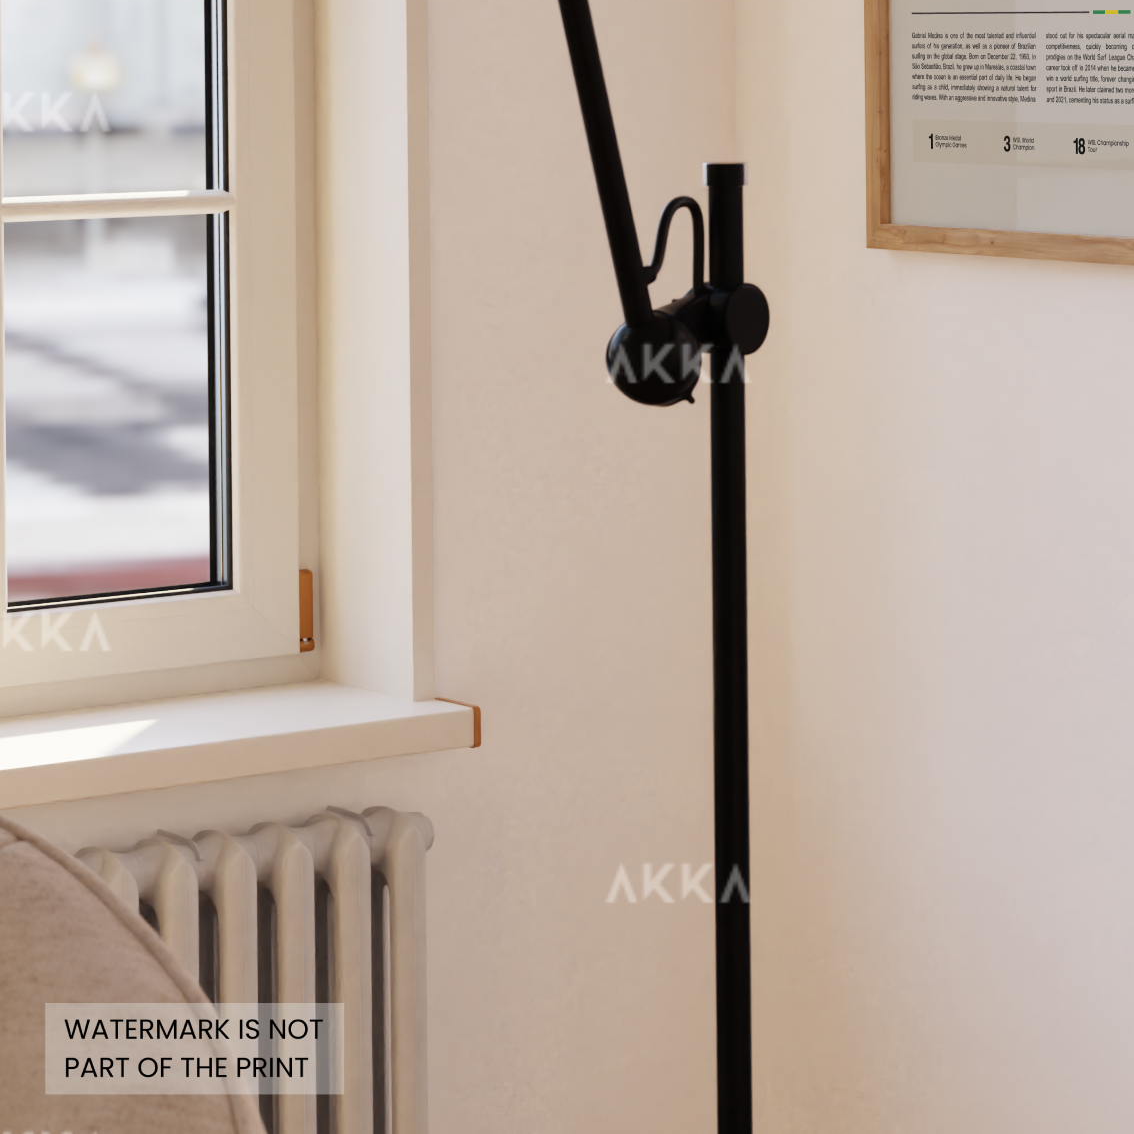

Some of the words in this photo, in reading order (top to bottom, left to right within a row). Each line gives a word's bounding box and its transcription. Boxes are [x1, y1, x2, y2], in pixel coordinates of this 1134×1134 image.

[1086, 32, 1111, 40] spectacular
[928, 133, 934, 150] 1
[1004, 136, 1010, 152] 3
[1073, 138, 1086, 154] 18
